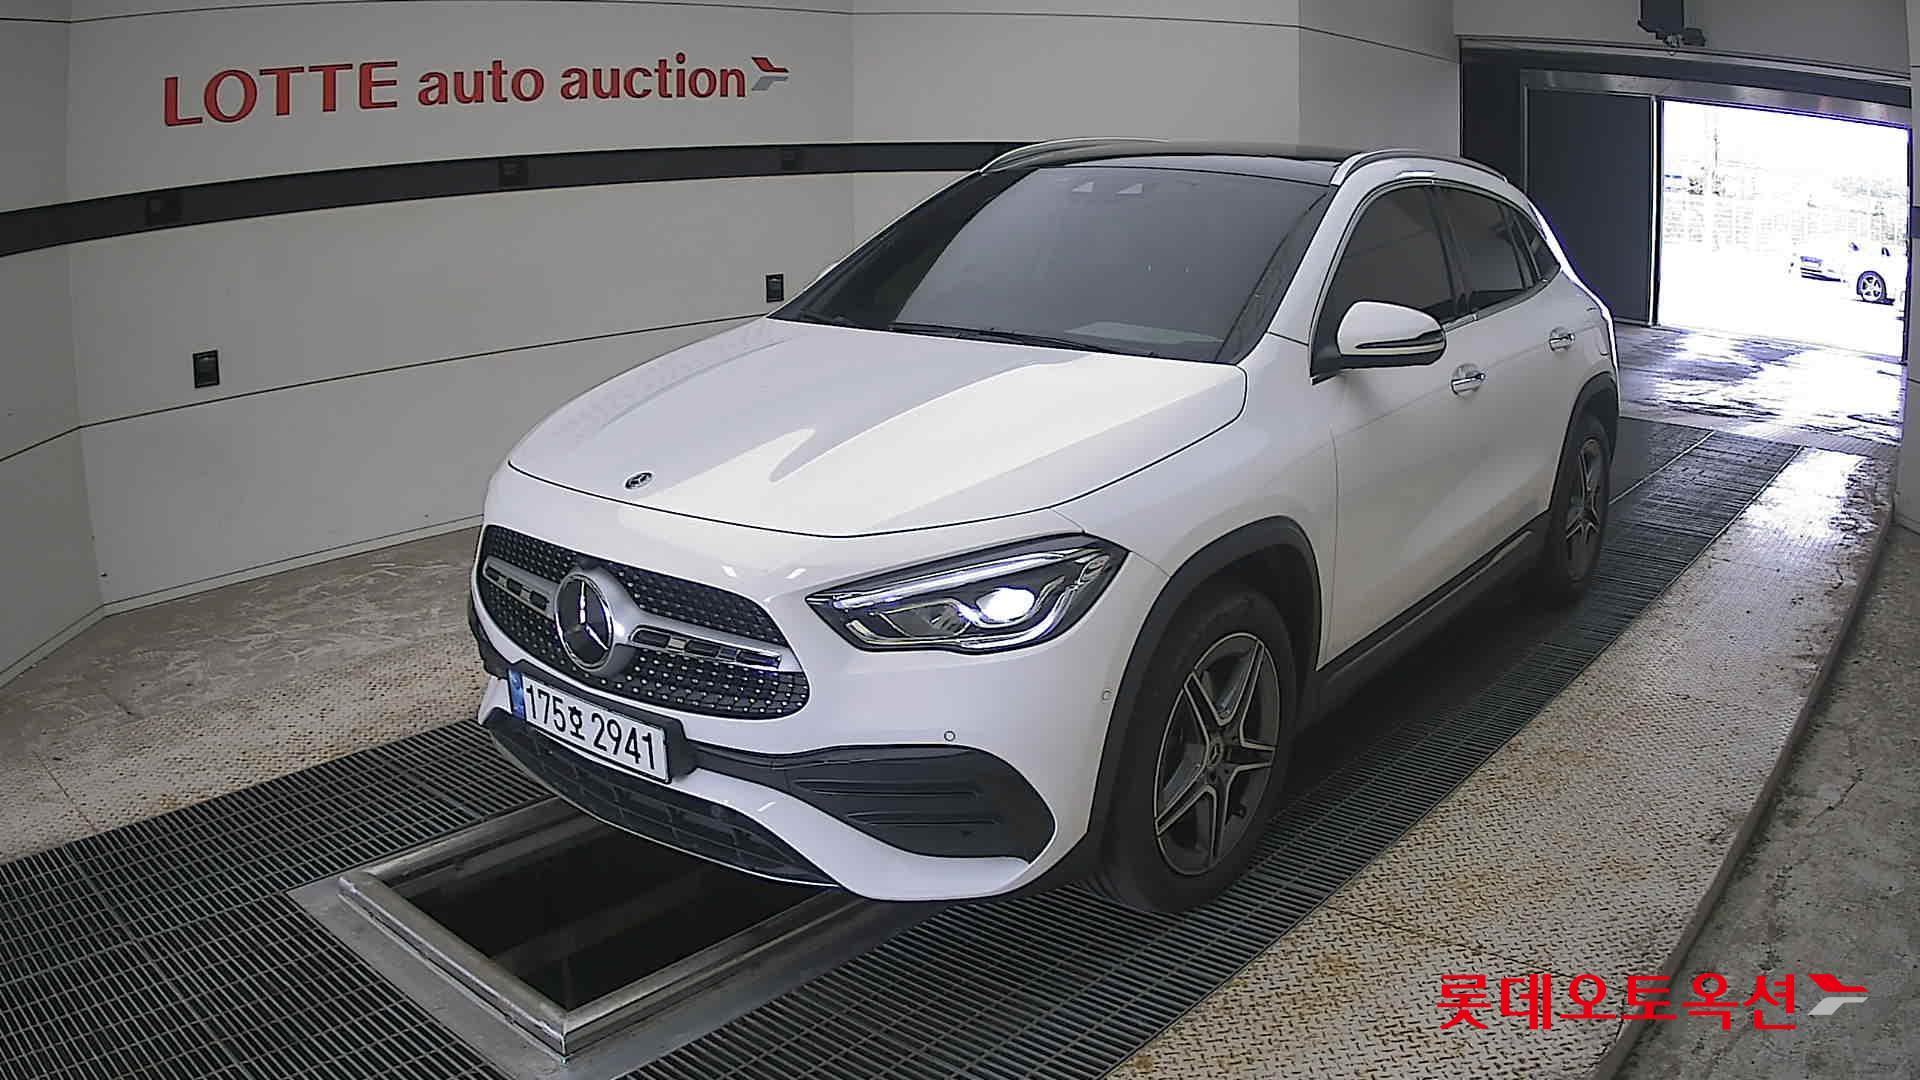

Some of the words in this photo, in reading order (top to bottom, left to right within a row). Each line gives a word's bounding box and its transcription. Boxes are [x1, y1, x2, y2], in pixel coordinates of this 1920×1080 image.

[164, 61, 398, 127] LOTTE
[417, 59, 545, 106] auto
[560, 52, 747, 101] auction
[526, 684, 586, 741] 175호
[591, 712, 655, 770] 2941
